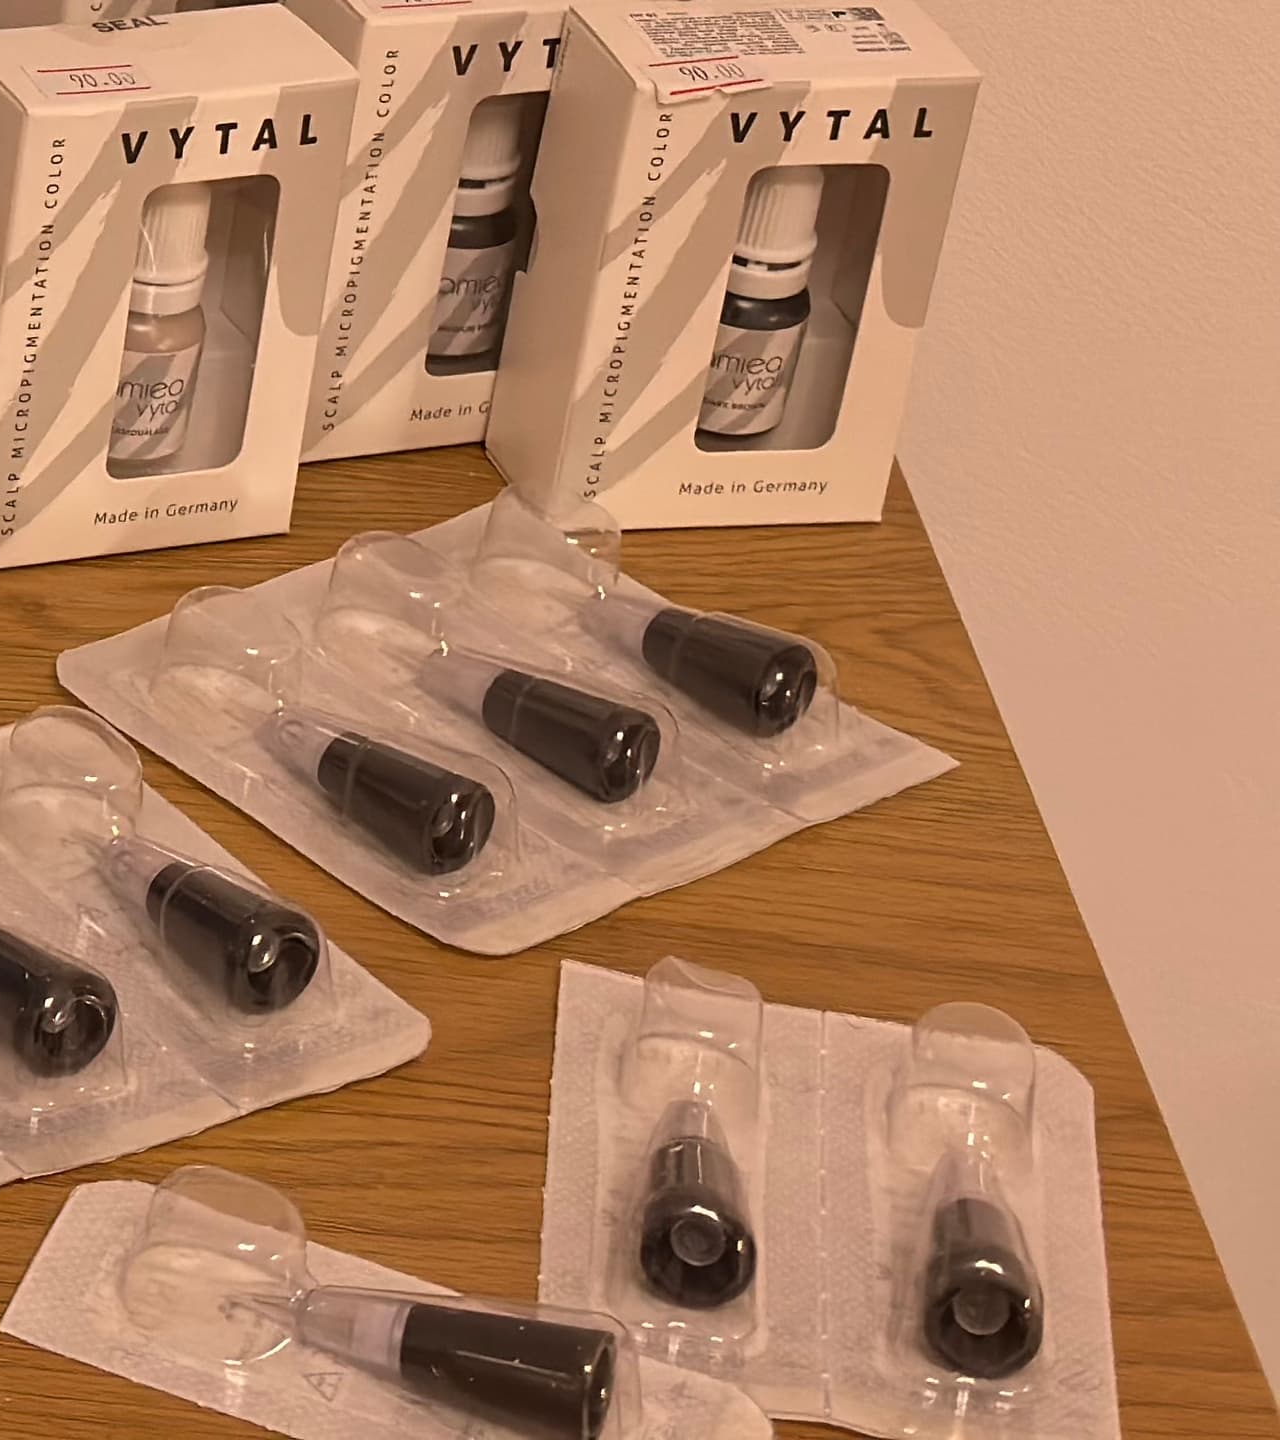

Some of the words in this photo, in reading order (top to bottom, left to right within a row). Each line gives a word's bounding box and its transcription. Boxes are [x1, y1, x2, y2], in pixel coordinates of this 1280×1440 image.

[91, 16, 169, 34] SEAL
[679, 62, 745, 81] 90.00
[121, 113, 318, 164] VYTAL
[730, 107, 933, 143] VYTAL
[322, 370, 343, 431] SCALP
[336, 131, 385, 357] MICROPIGMENTATION
[377, 48, 399, 117] COLOR
[583, 435, 606, 499] SCALP
[600, 195, 655, 424] MICROPIGMENTATION
[648, 112, 673, 182] COLOR
[1, 472, 20, 536] SCALP
[12, 222, 55, 459] MICROPIGMENTATION
[45, 137, 66, 209] COLOR
[409, 407, 452, 421] Made
[459, 404, 472, 416] in
[678, 481, 725, 496] Made
[730, 481, 747, 495] in
[752, 478, 828, 496] Germany
[93, 507, 139, 526] Made
[144, 504, 160, 520] in
[166, 497, 239, 520] Germany
